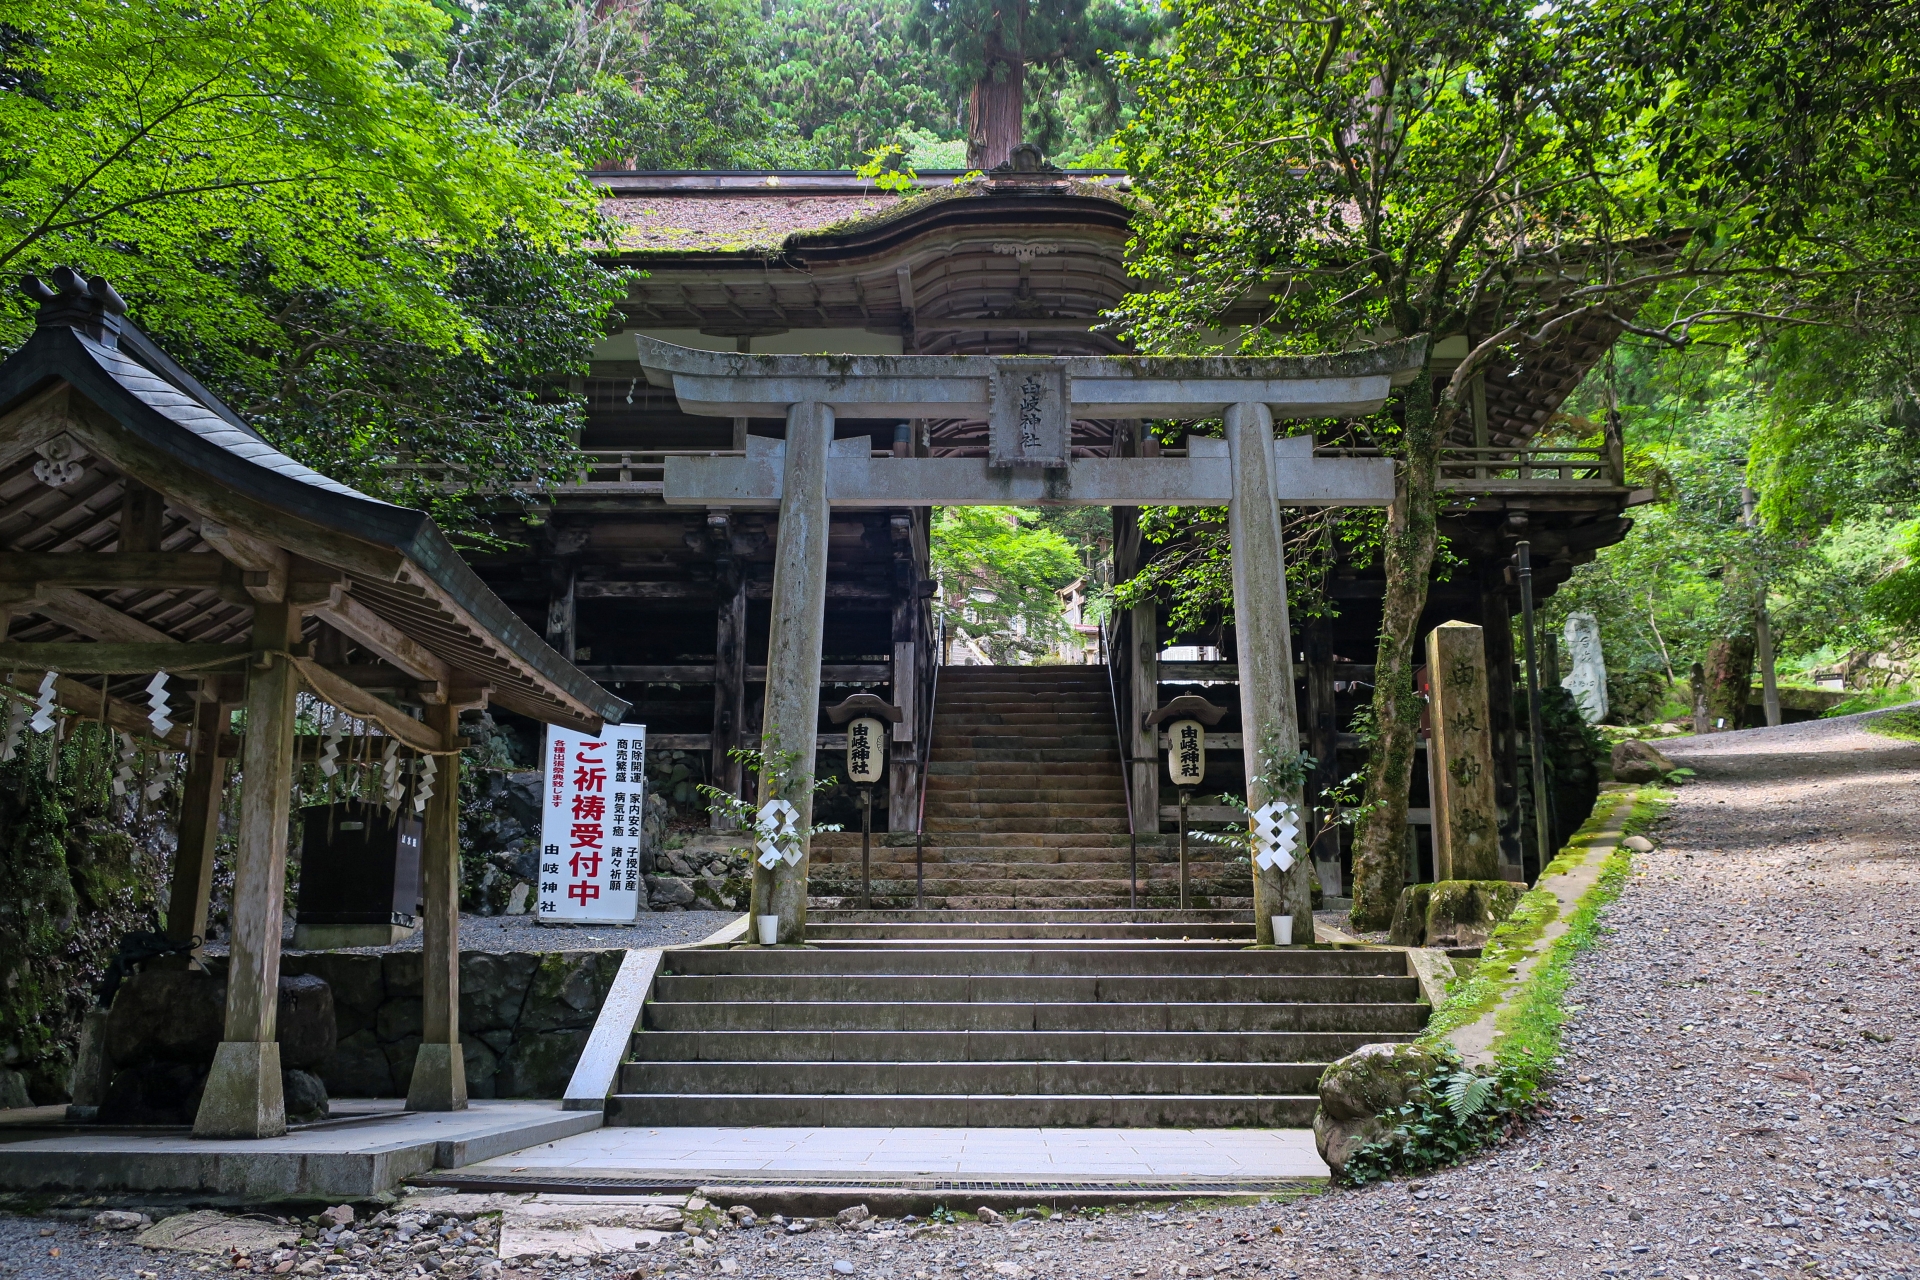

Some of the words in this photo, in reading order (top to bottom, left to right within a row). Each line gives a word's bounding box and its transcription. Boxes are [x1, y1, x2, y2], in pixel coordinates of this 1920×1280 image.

[1019, 376, 1042, 449] 由岐神社
[551, 739, 566, 808] 各種出張祭典致します
[615, 739, 629, 783] 商売繁盛
[629, 739, 643, 784] 厄除開運
[851, 723, 870, 775] 由岐神社
[1180, 725, 1199, 777] 由岐神社
[1451, 663, 1487, 832] 由岐神社
[567, 741, 608, 907] ご祈祷受付中
[612, 792, 626, 837] 病気平癒
[628, 793, 641, 837] 家内安全
[540, 844, 559, 912] 由岐神社
[609, 846, 623, 891] 諸々祈願
[624, 846, 639, 891] 子授安産
